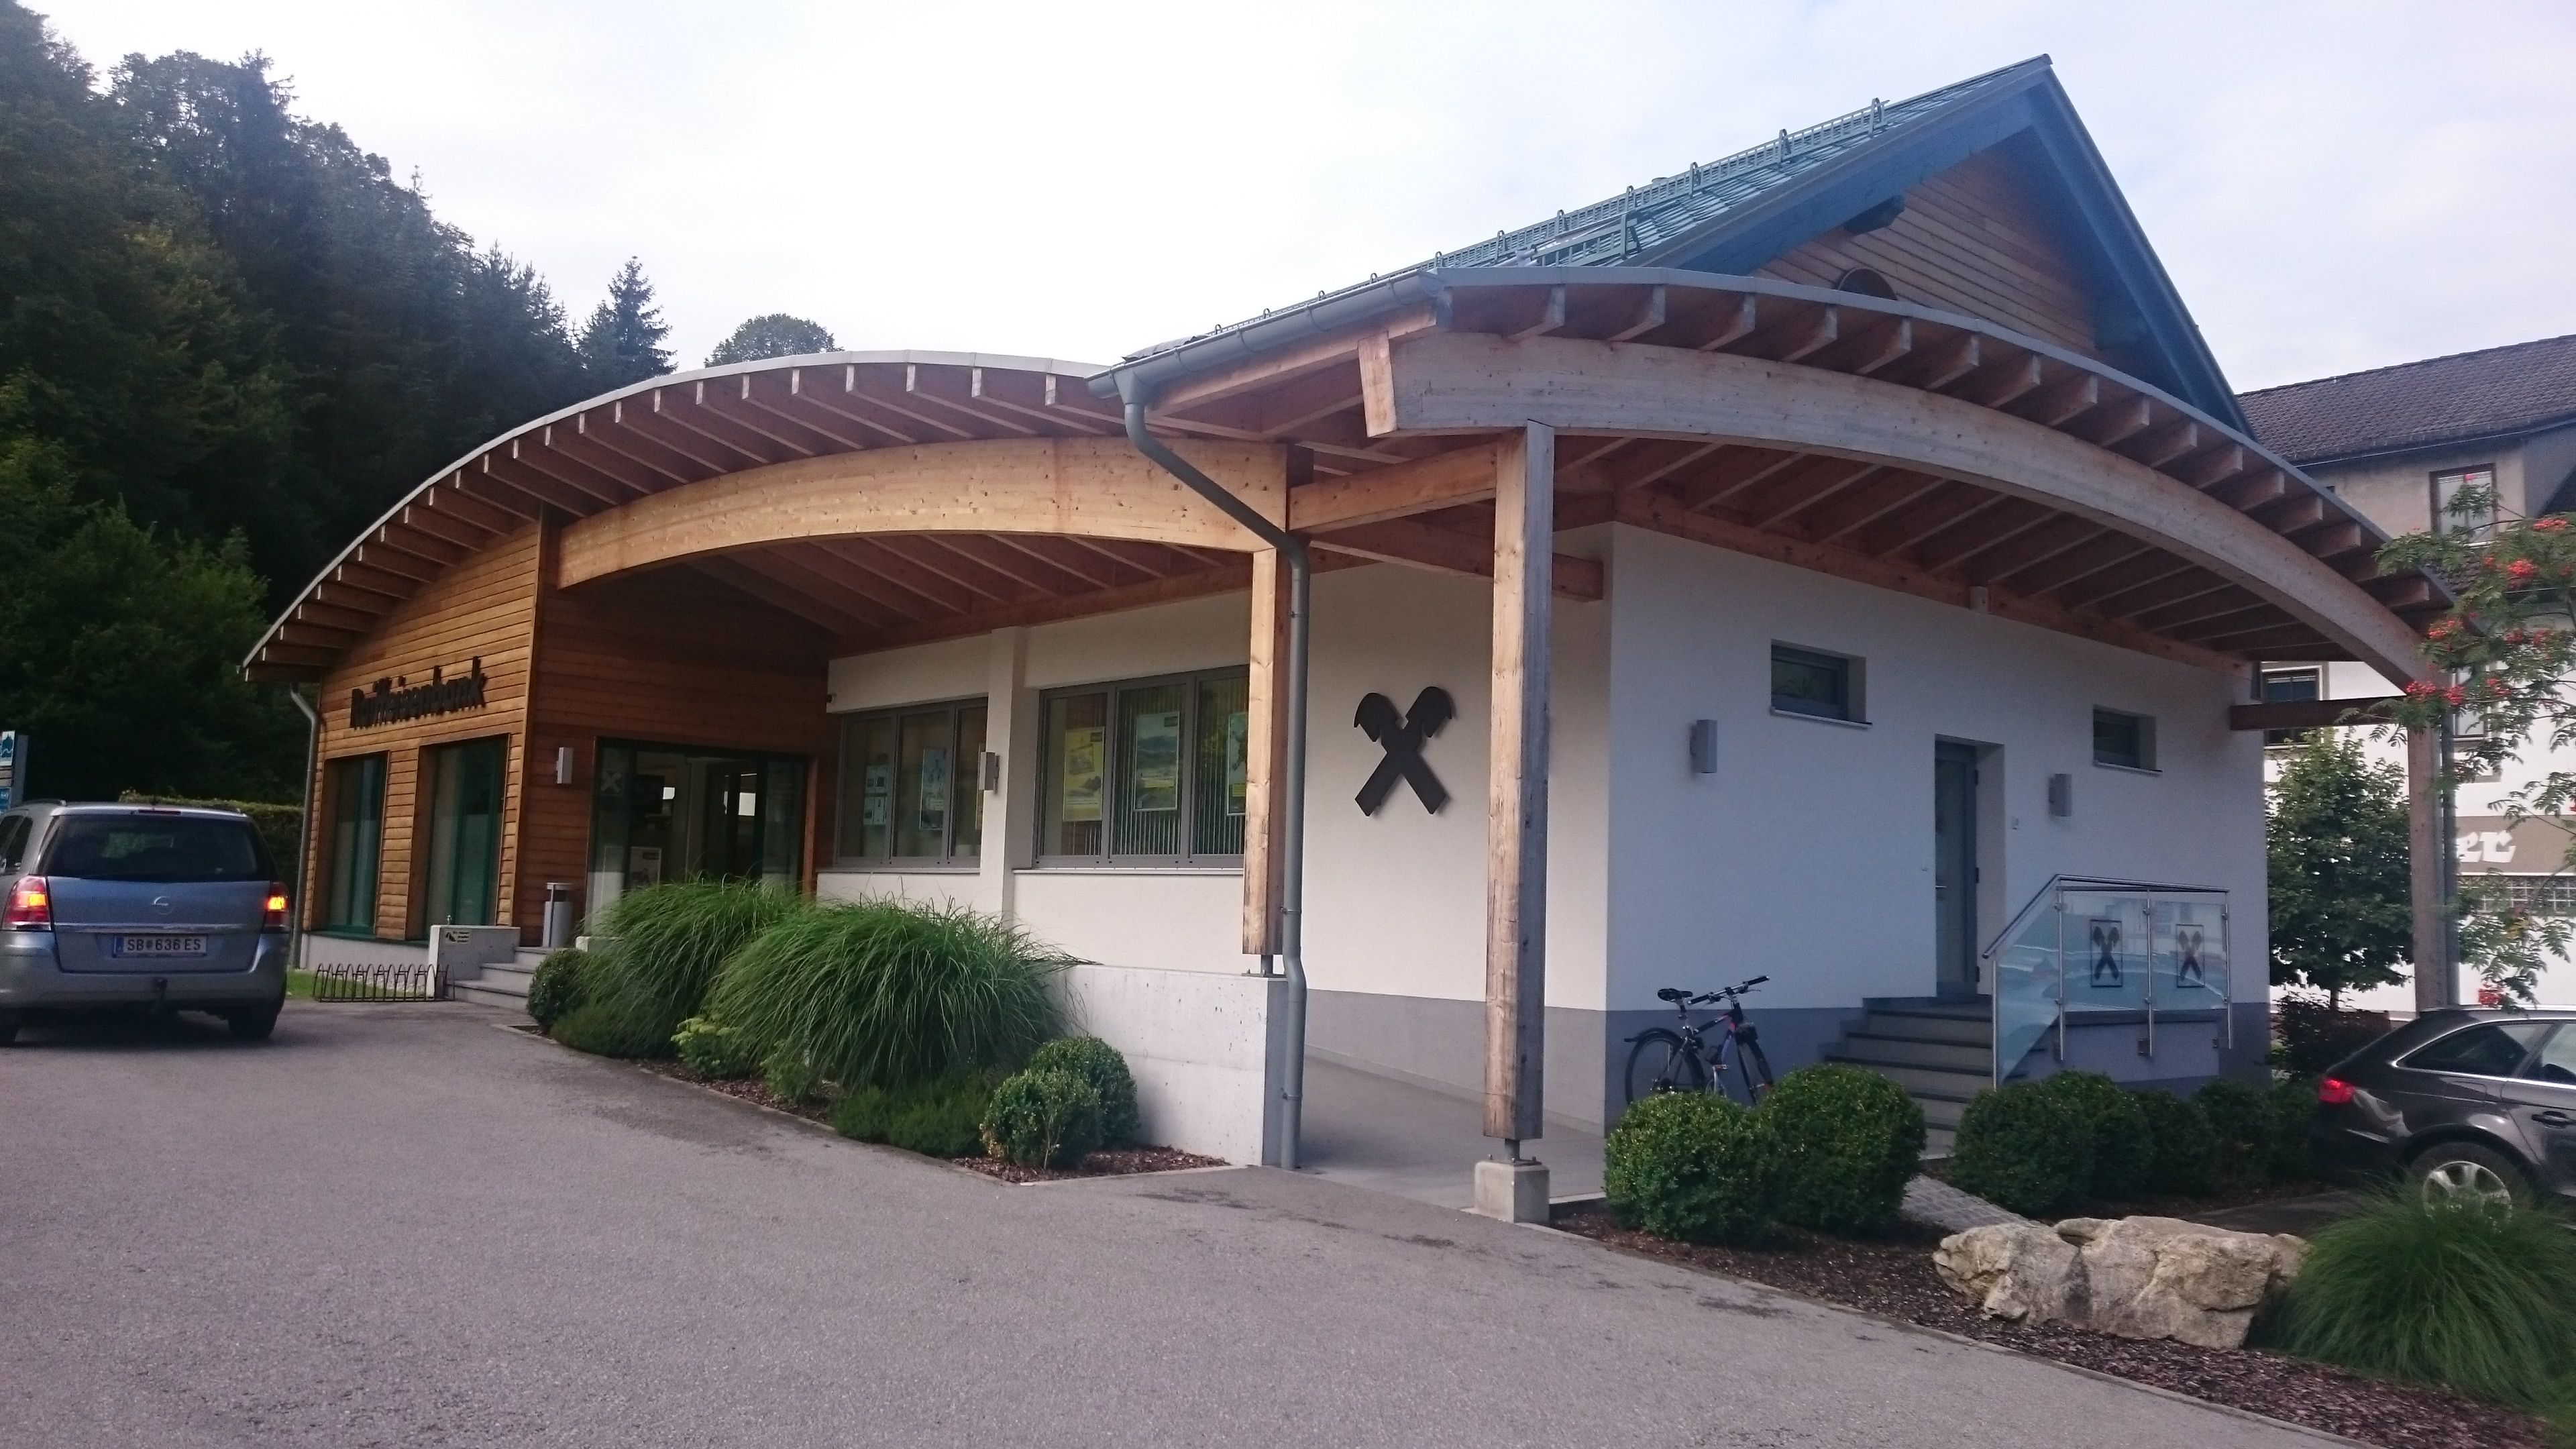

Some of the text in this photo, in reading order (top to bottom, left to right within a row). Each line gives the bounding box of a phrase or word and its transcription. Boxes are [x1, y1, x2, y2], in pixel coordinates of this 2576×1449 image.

[350, 656, 488, 730] Riinbank
[127, 939, 144, 951] SB
[184, 939, 201, 951] ES
